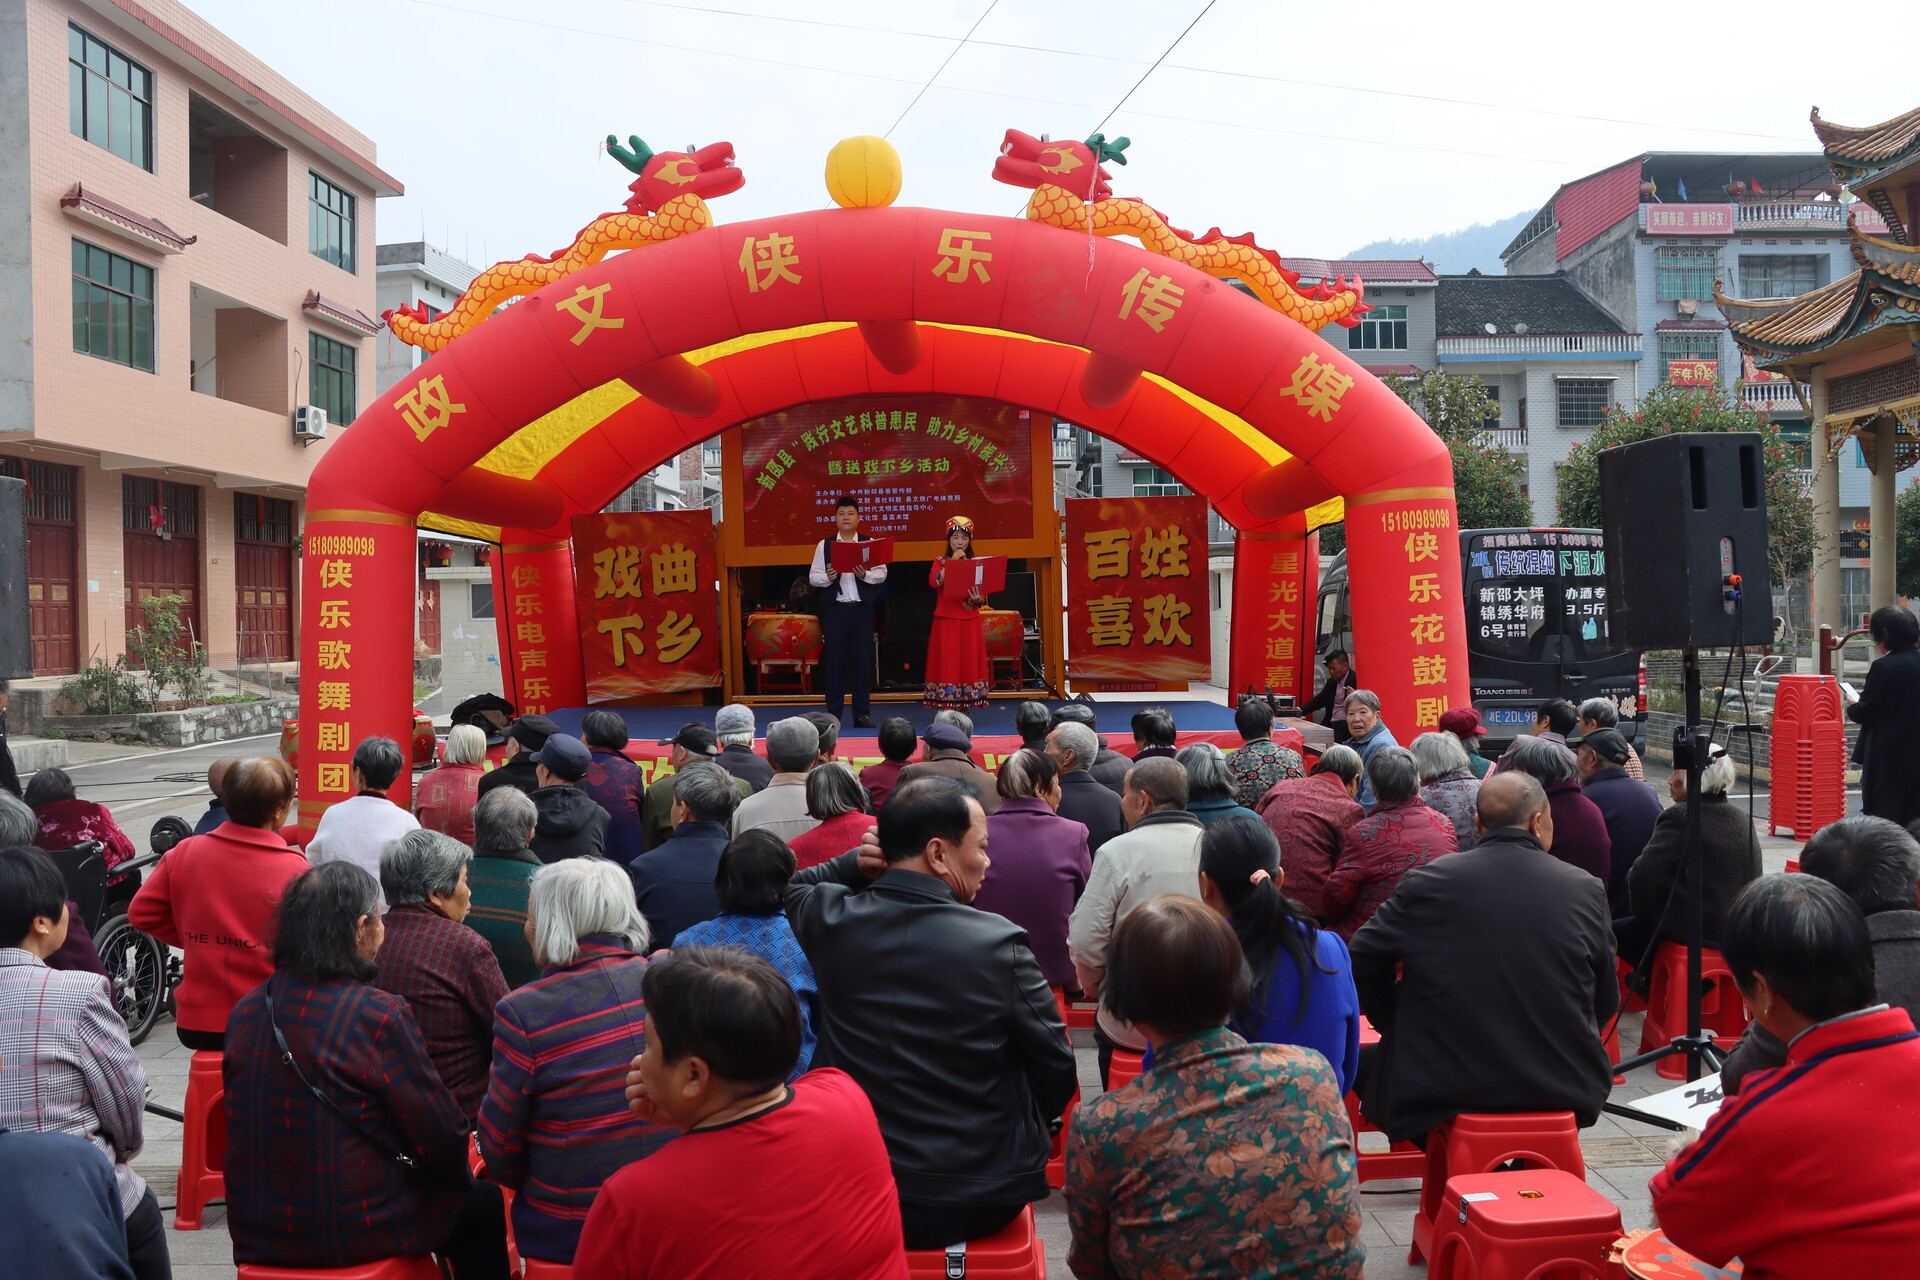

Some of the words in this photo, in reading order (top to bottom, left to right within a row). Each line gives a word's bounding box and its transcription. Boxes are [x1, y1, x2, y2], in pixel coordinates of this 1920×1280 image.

[393, 228, 1354, 443] 政文侠乐传媒
[827, 458, 949, 476] 暨送戏下乡活动
[1381, 508, 1450, 533] 15180989098
[308, 535, 375, 557] 15180989098
[1084, 524, 1190, 581] 百姓
[593, 542, 697, 599] 戏曲
[1480, 587, 1545, 602] 新邵大坪
[1480, 605, 1545, 620] 锦绣华府
[597, 611, 702, 667] 下乡
[1086, 593, 1192, 647] 喜欢
[1481, 623, 1505, 638] 6号
[317, 559, 353, 793] 侠乐歌舞剧团
